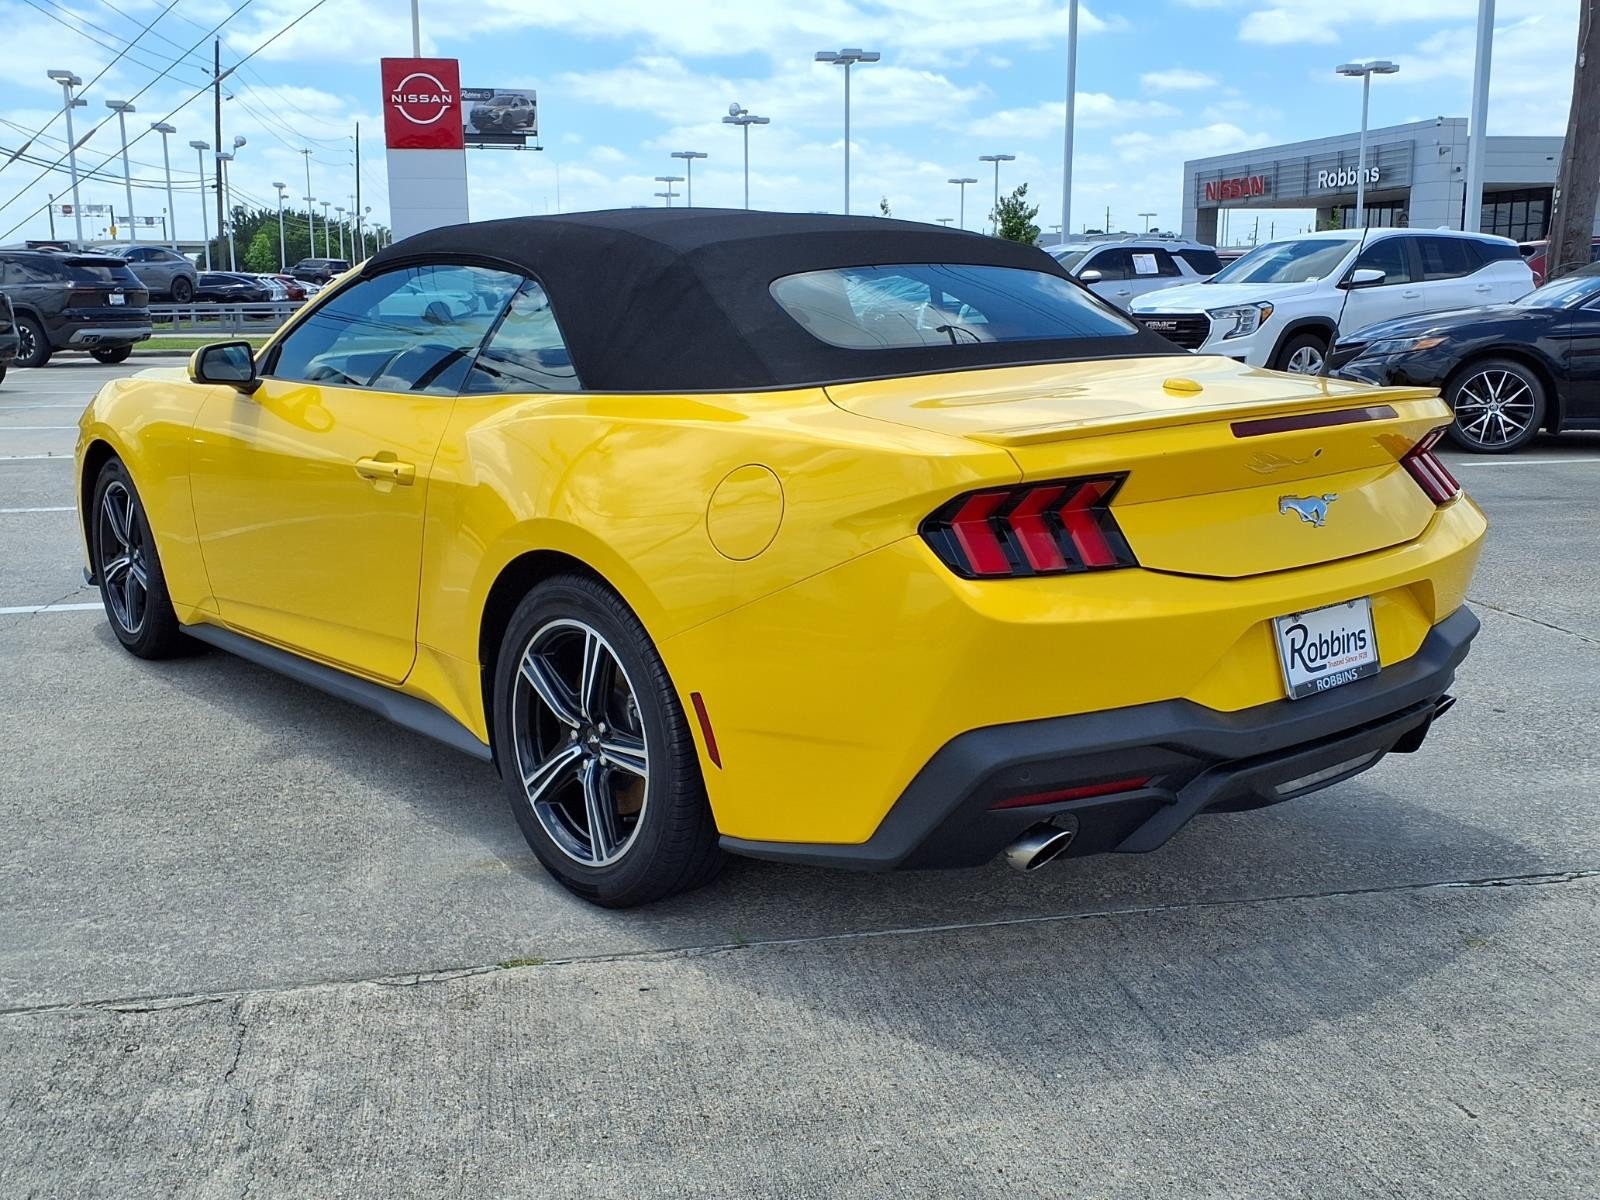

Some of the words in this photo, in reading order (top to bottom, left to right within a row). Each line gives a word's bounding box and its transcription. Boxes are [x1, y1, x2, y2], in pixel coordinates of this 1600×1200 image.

[391, 94, 452, 103] NISSAN
[1205, 174, 1265, 201] NISSAN
[1318, 166, 1380, 189] Robbins
[1145, 321, 1177, 330] GMC
[1285, 623, 1367, 674] Robbins
[1345, 655, 1358, 664] Since
[1316, 668, 1358, 691] ROBBINS
